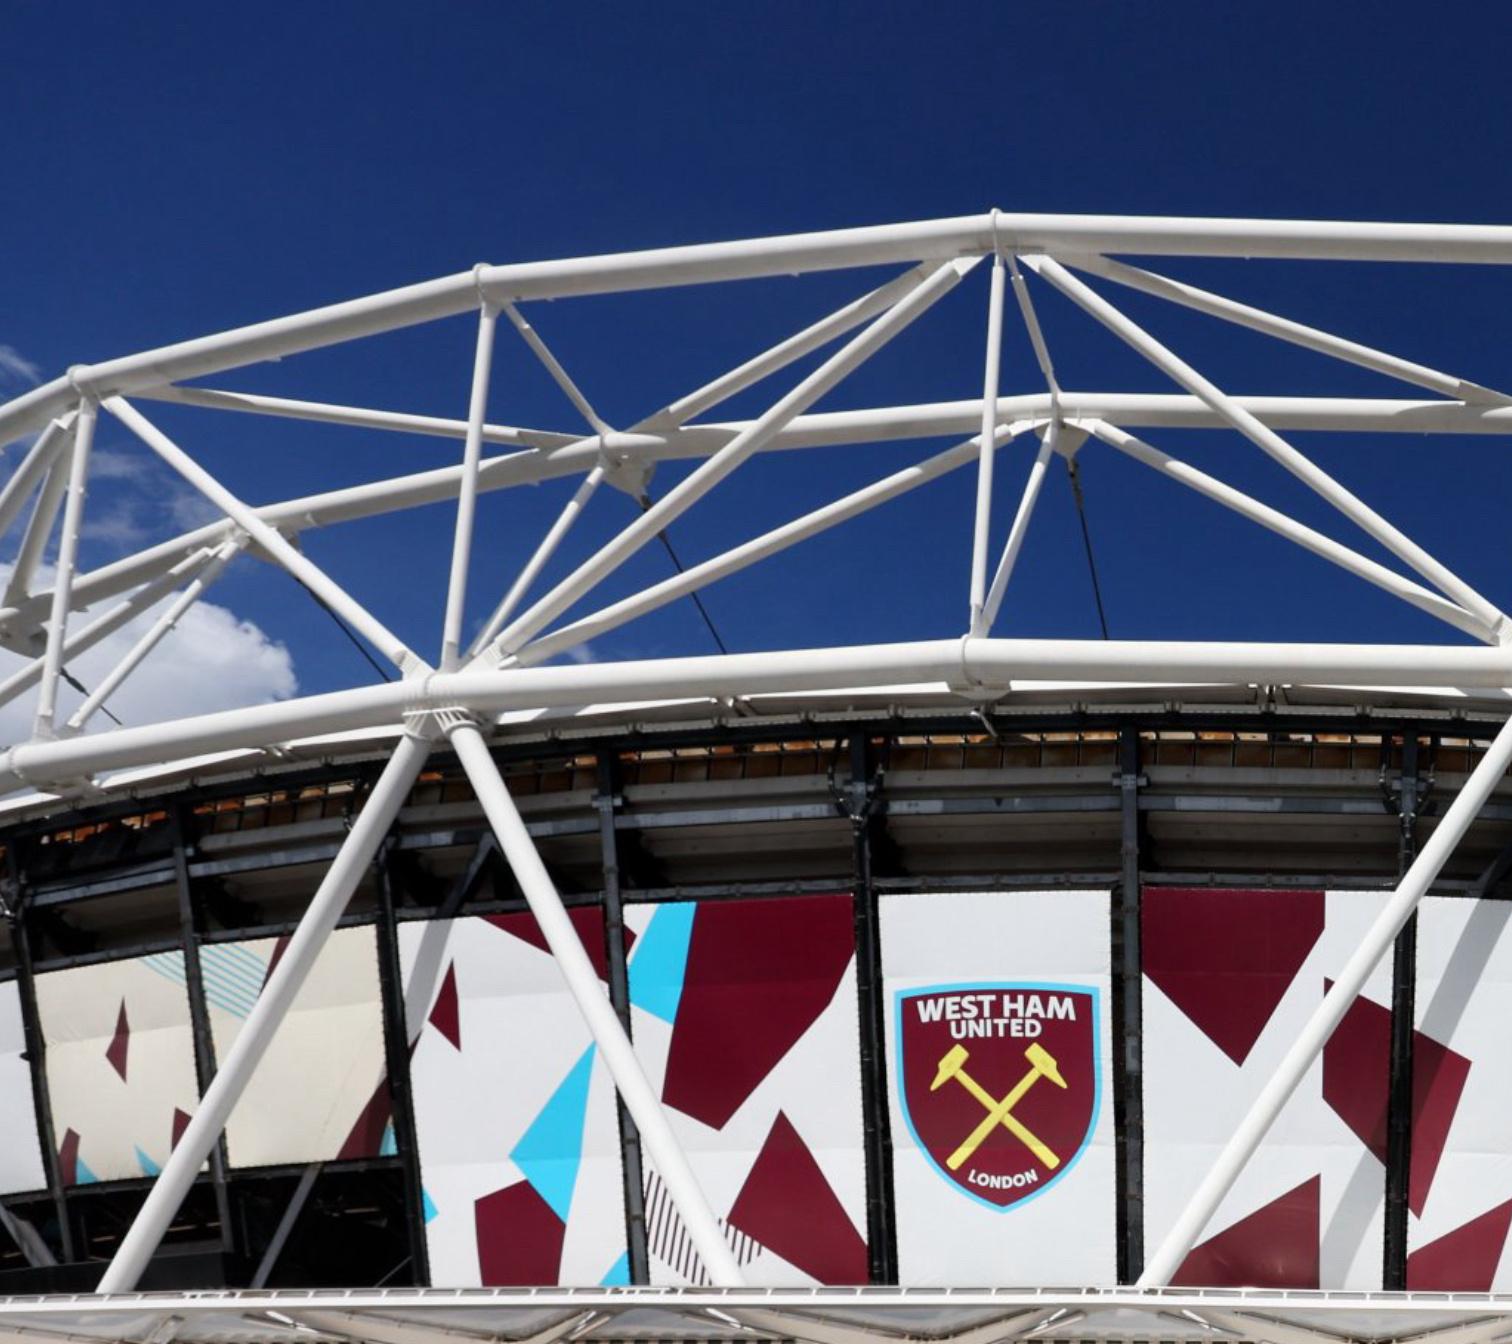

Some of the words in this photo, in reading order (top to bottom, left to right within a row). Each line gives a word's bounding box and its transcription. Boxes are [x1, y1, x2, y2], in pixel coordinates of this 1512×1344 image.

[916, 994, 996, 1023] WEST
[1002, 994, 1076, 1021] HAM
[951, 1018, 1042, 1039] UNITED
[967, 1168, 1039, 1190] LONDON
